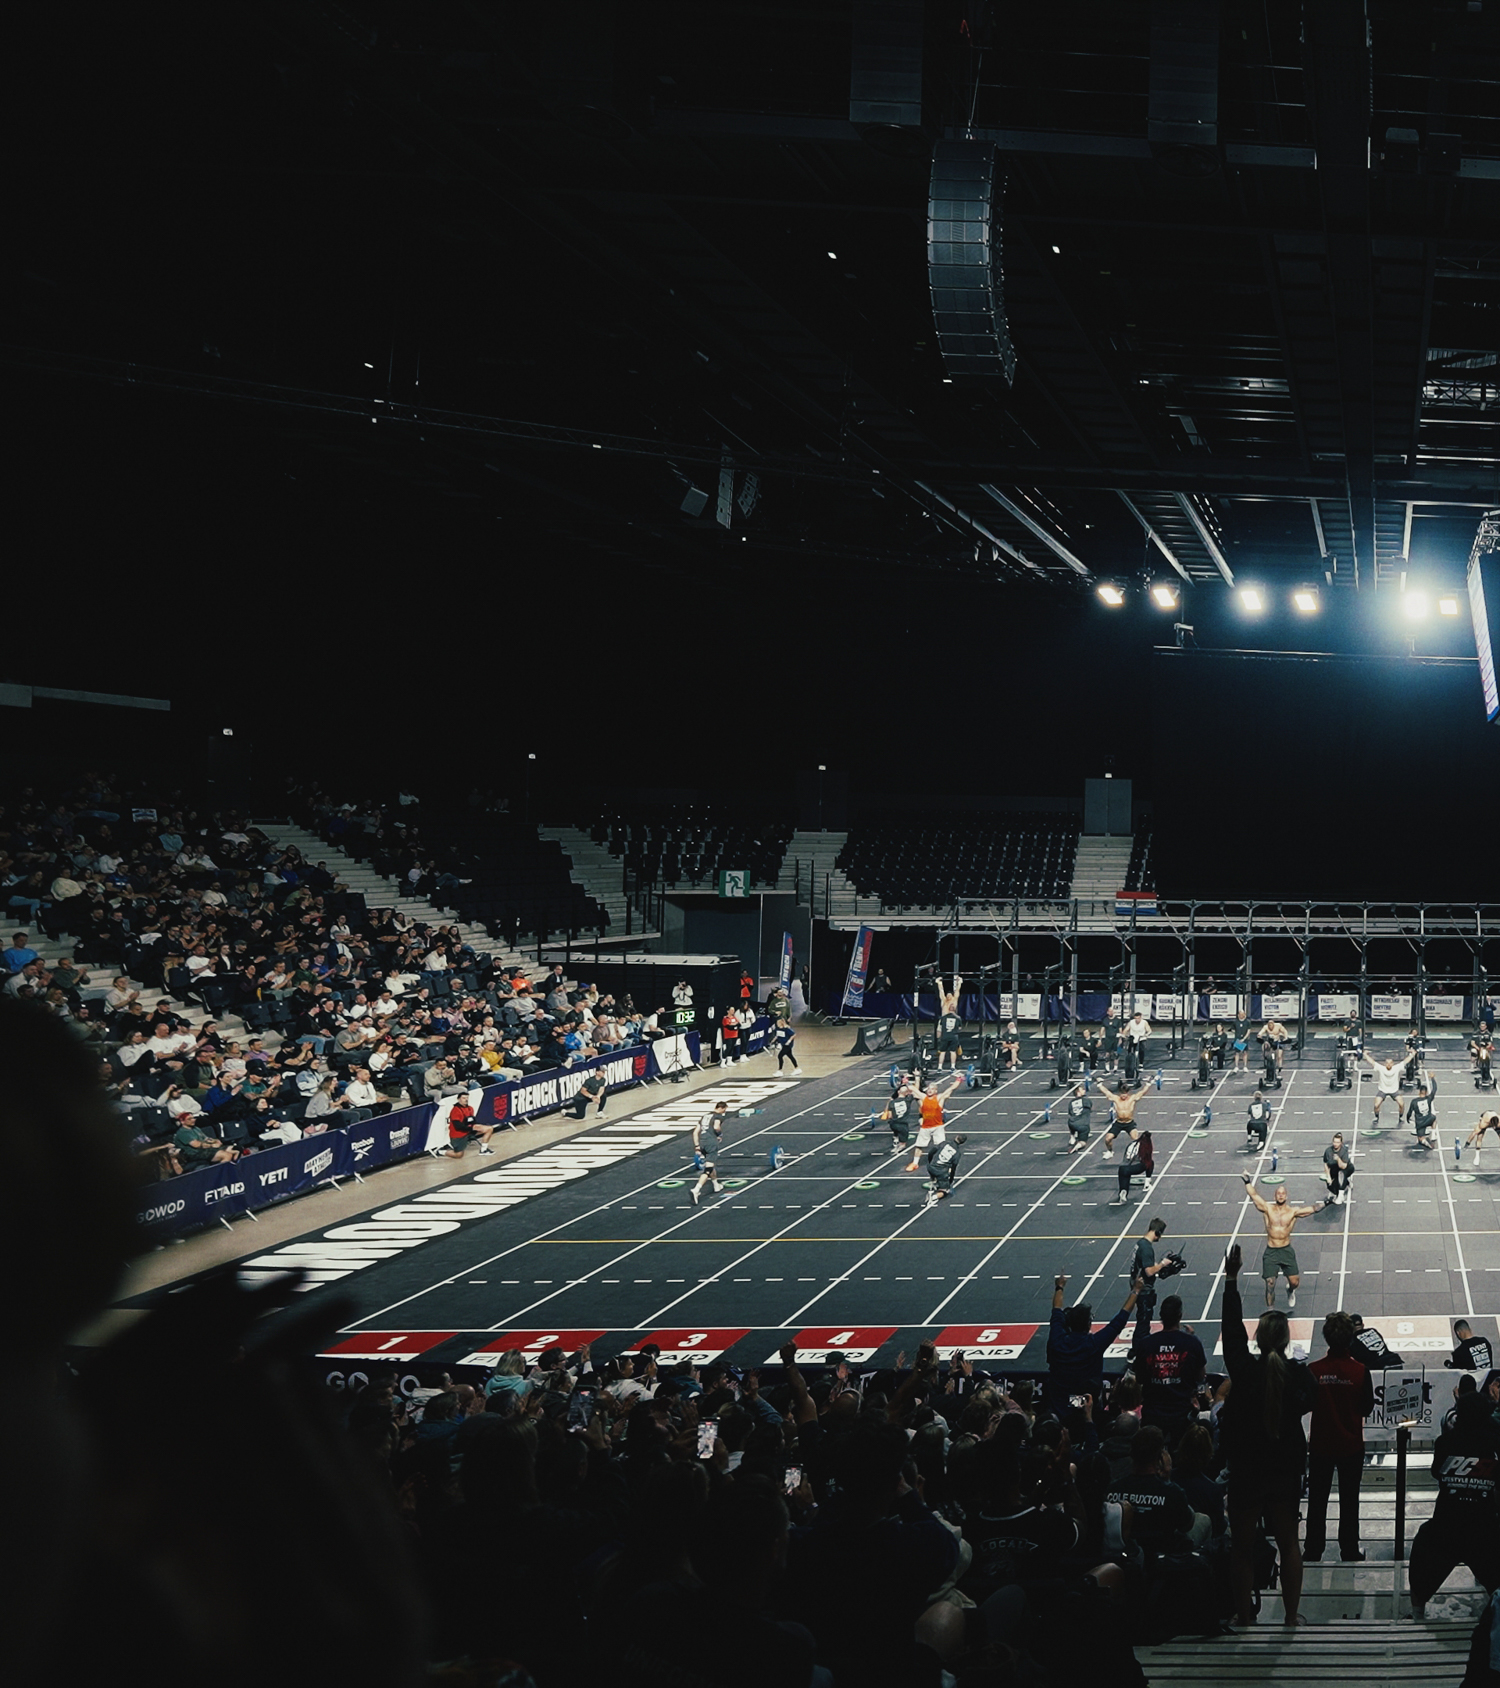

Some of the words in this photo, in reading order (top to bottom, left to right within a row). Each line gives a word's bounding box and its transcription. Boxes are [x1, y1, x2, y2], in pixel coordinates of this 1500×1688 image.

[511, 1081, 558, 1117] FRENCH
[258, 1167, 288, 1187] YETI
[204, 1182, 245, 1204] FITAID
[136, 1199, 185, 1224] GOWOD
[1396, 1322, 1415, 1335] 8
[377, 1336, 408, 1350] 1
[524, 1334, 559, 1348] 2
[678, 1333, 708, 1347] 3
[827, 1332, 855, 1345] 4
[976, 1329, 1002, 1343] 5
[1160, 1345, 1175, 1353] FLY
[1107, 1493, 1128, 1502] COLE
[1130, 1494, 1165, 1506] BUXTON
